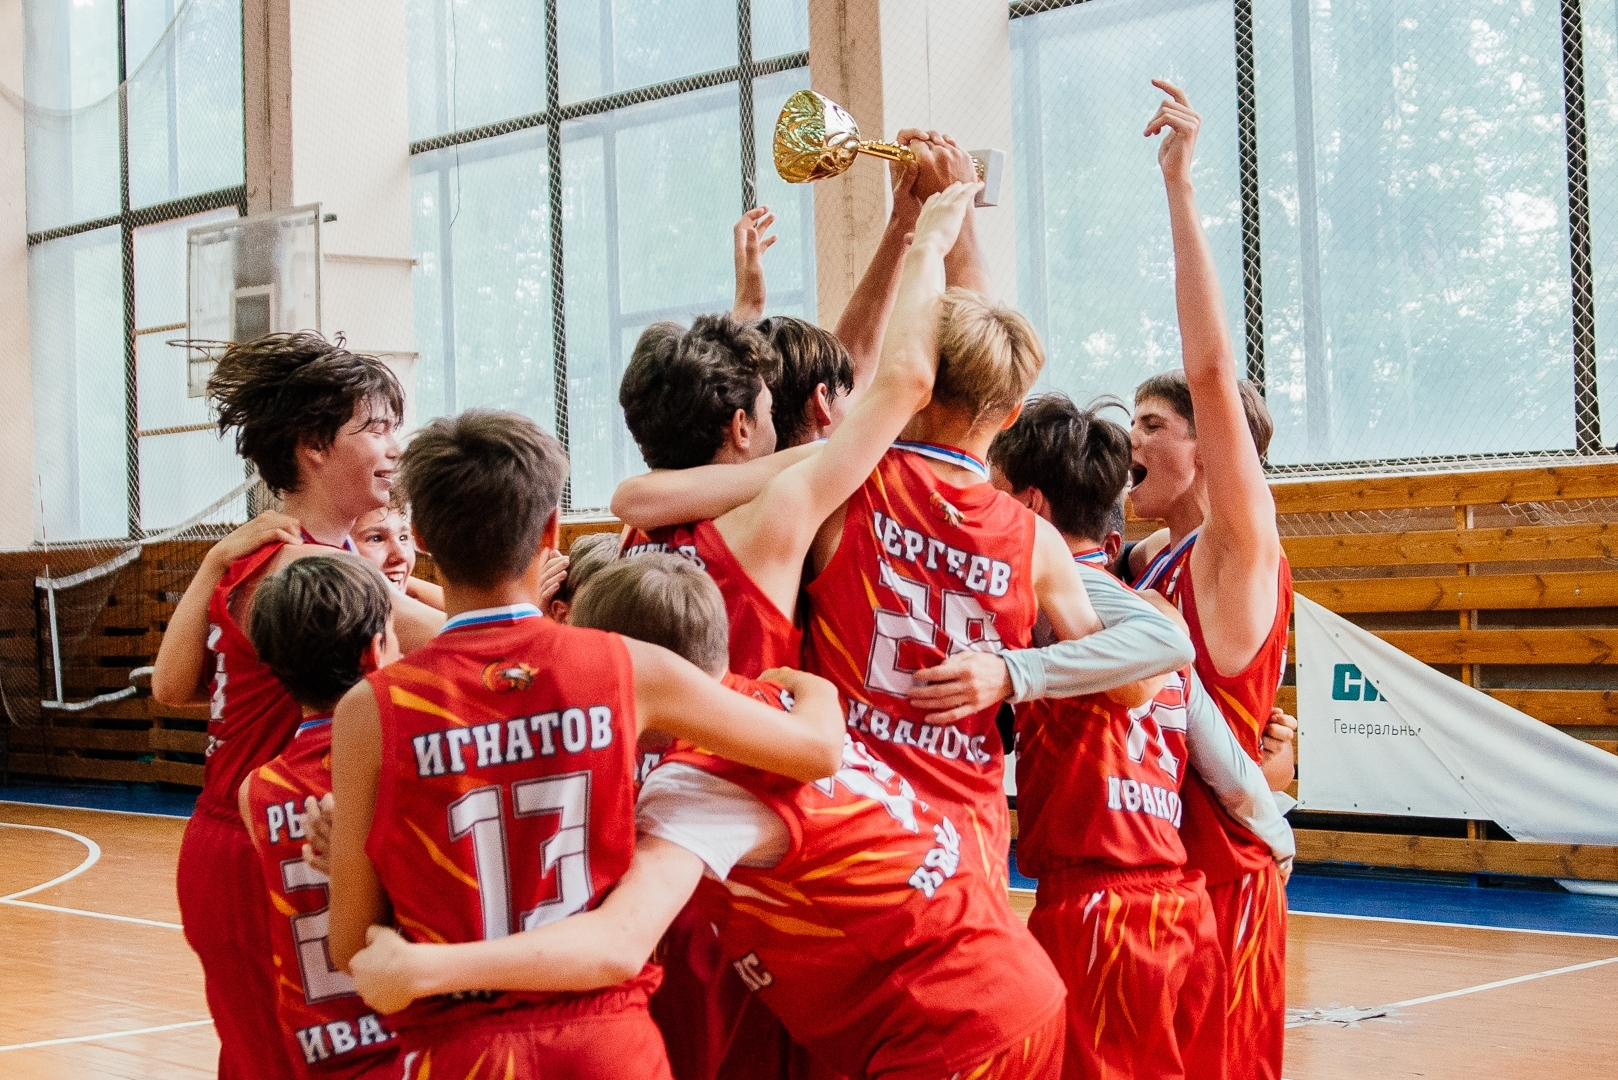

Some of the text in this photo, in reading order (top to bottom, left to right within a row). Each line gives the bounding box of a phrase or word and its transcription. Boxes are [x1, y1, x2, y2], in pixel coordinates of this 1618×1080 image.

[413, 704, 613, 777] ИГНАТОВ
[447, 770, 595, 941] 13
[296, 1013, 398, 1065] ИВА
